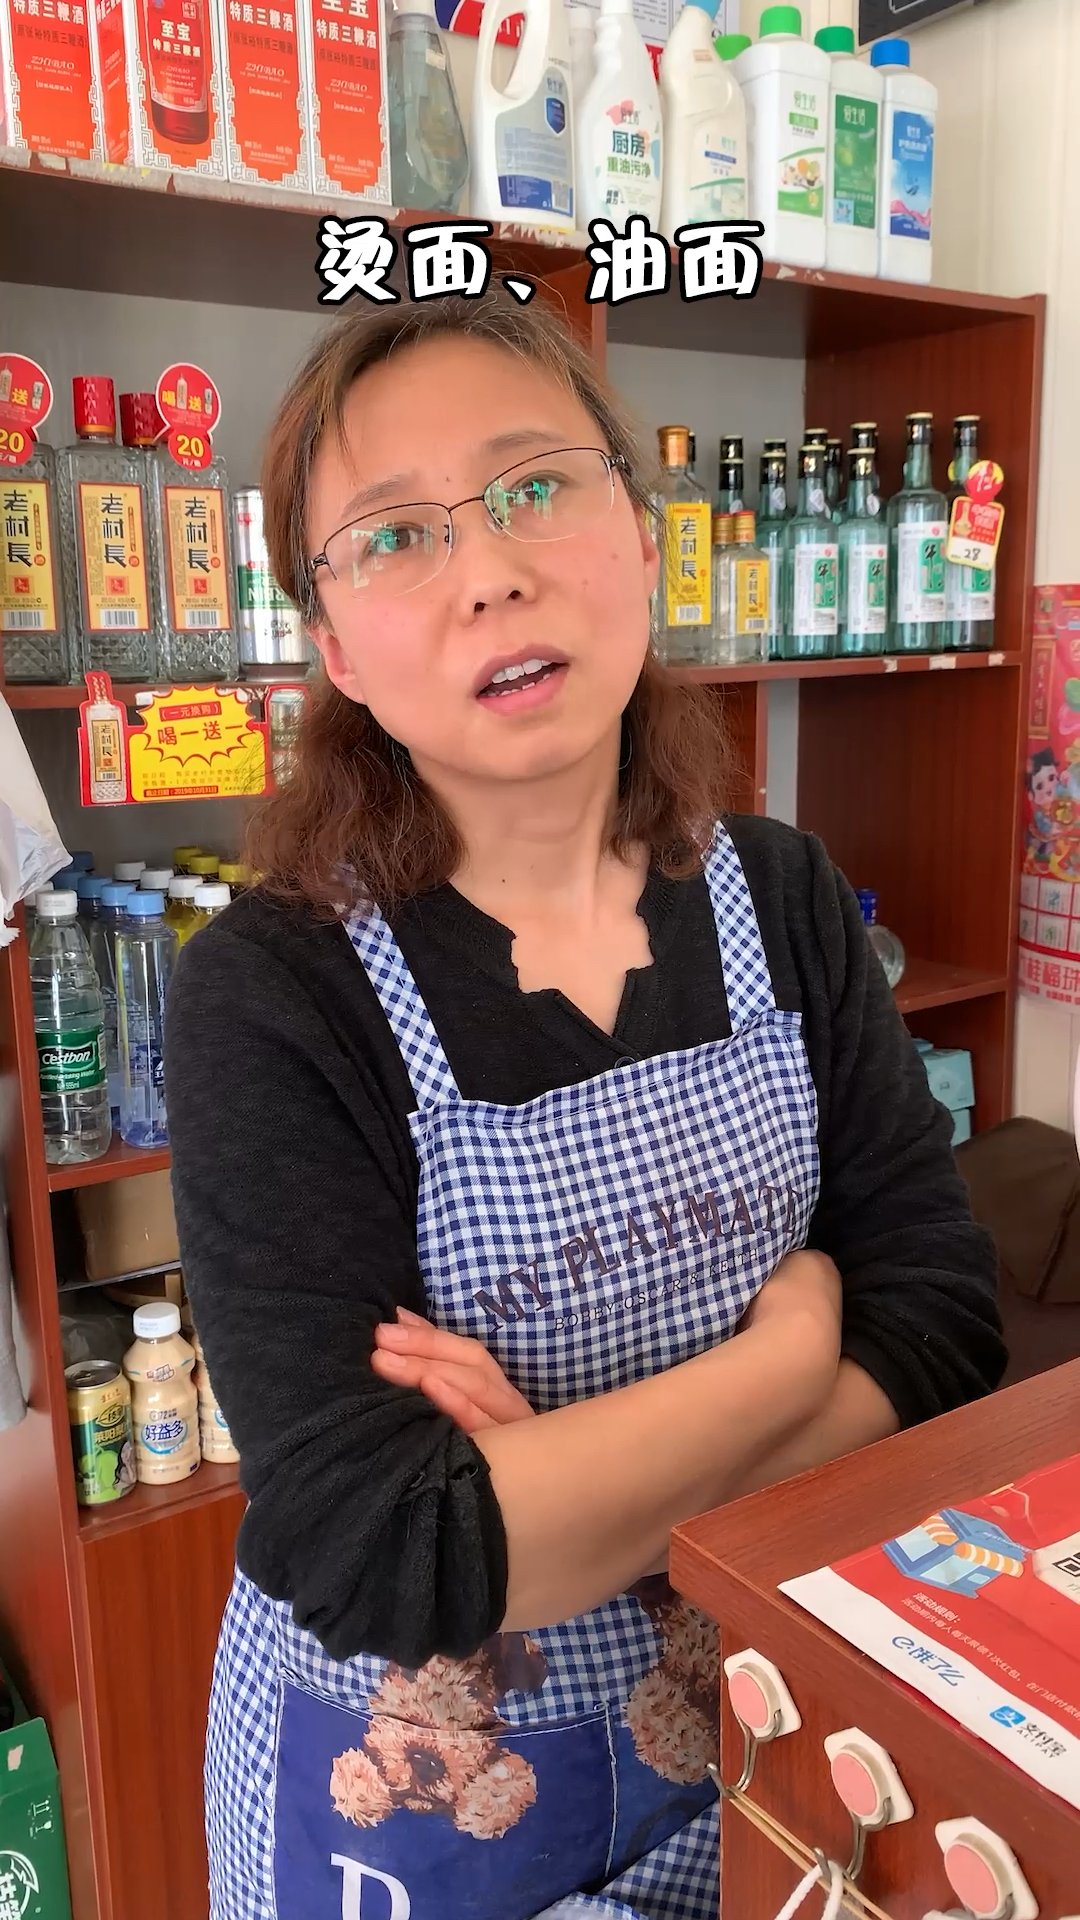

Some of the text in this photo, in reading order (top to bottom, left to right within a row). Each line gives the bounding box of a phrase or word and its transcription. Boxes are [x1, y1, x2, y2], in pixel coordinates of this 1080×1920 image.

[161, 19, 191, 42] 至宝
[612, 130, 645, 158] 厨房
[12, 388, 28, 406] 送
[177, 435, 204, 457] 20
[964, 547, 981, 561] 28
[157, 720, 243, 746] 喝一送一
[708, 1248, 758, 1278] KEITH
[473, 1260, 551, 1332] MY
[145, 1420, 184, 1441] 好益多
[908, 1646, 965, 1687] 饿了么
[1016, 1729, 1061, 1758] ALIPAY
[1020, 1722, 1067, 1754] 支付宝
